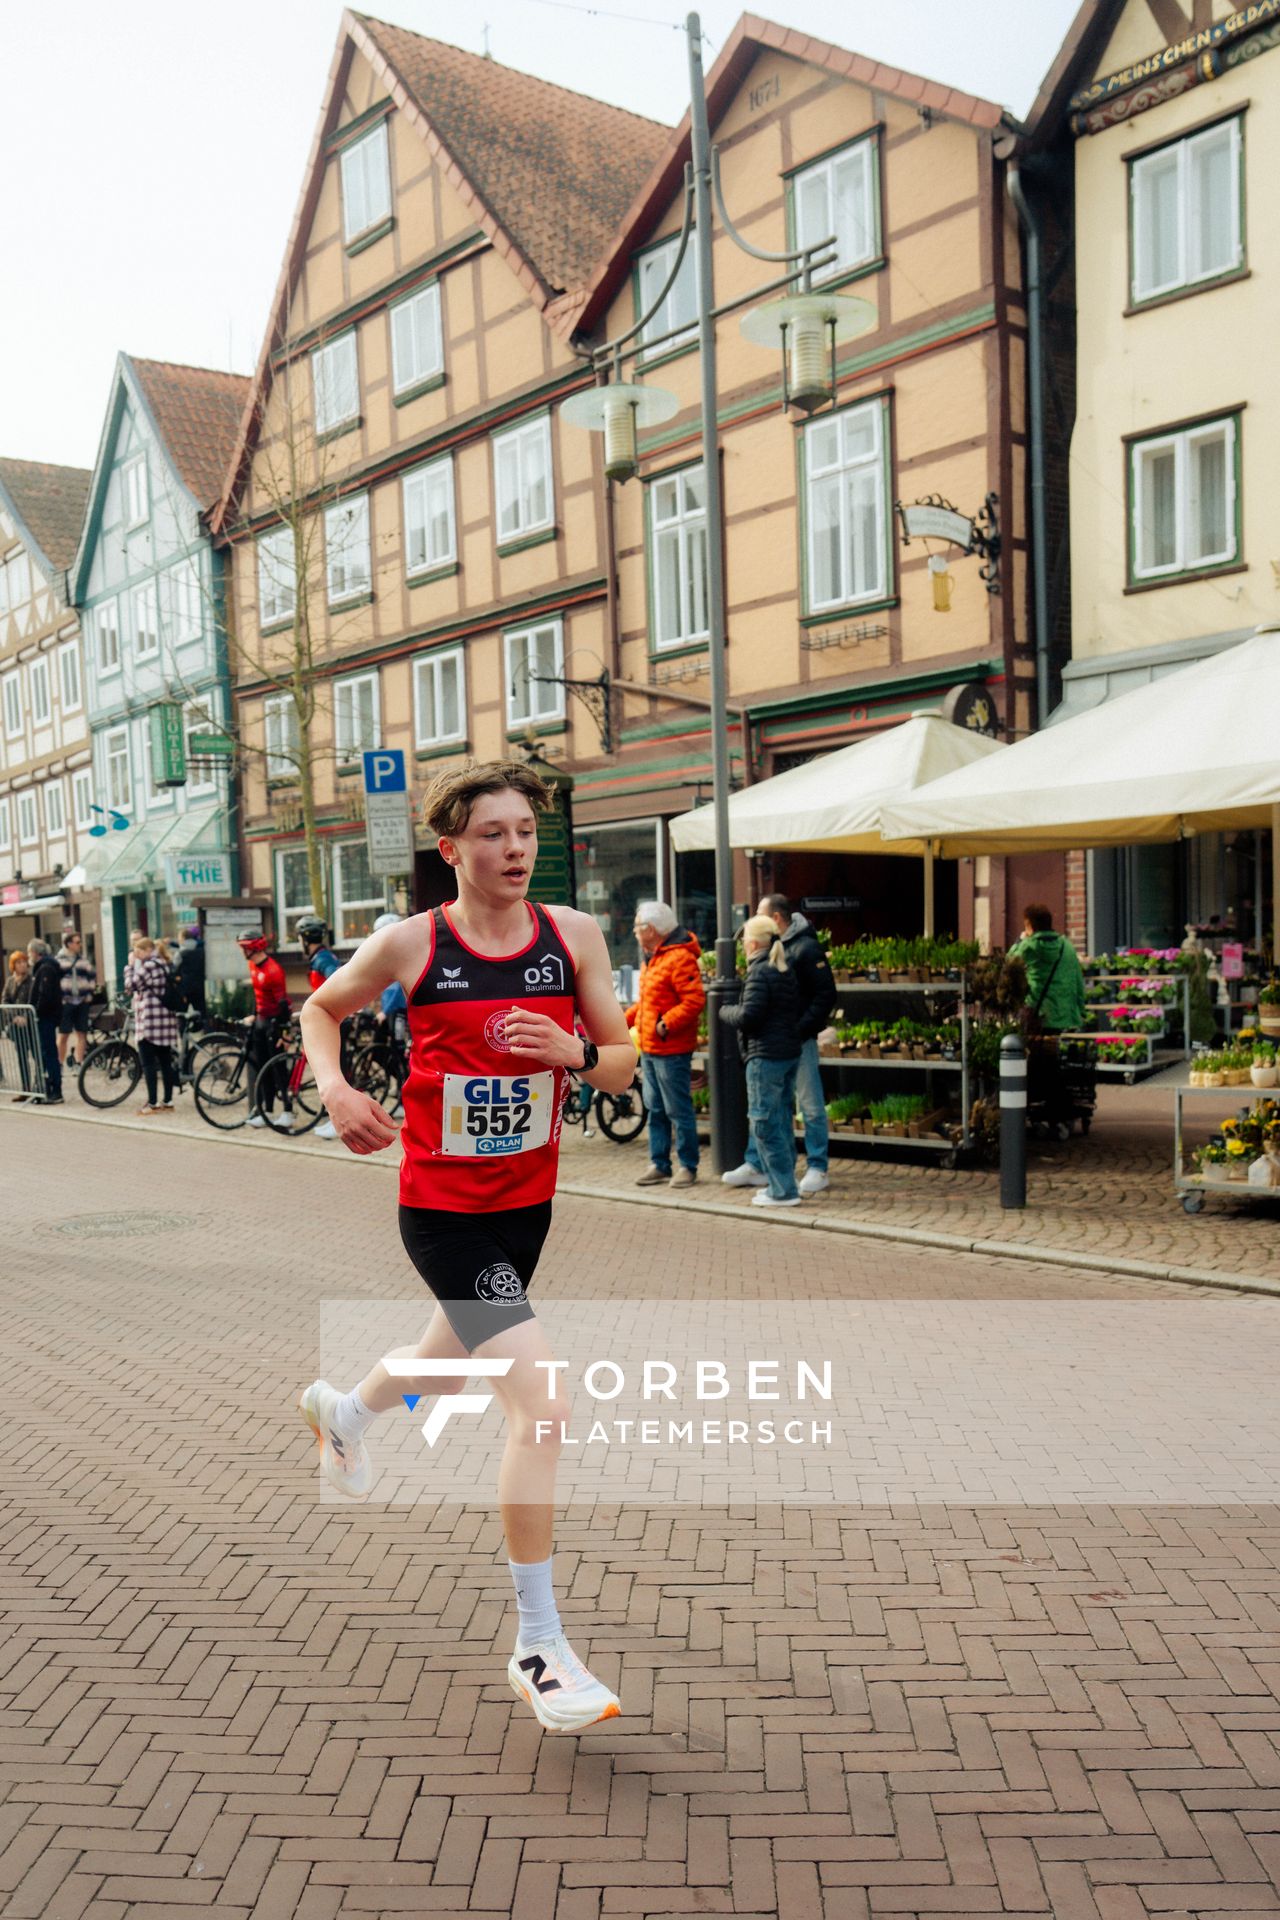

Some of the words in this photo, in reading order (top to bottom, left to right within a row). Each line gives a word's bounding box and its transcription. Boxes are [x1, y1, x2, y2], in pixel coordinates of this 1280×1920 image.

[167, 705, 183, 776] HOTEL
[373, 756, 396, 788] P
[177, 868, 223, 883] THIE
[524, 966, 554, 984] OS
[436, 979, 469, 989] erima
[525, 983, 561, 992] BauImmo
[467, 1104, 532, 1136] 552
[496, 1138, 520, 1147] PLAN
